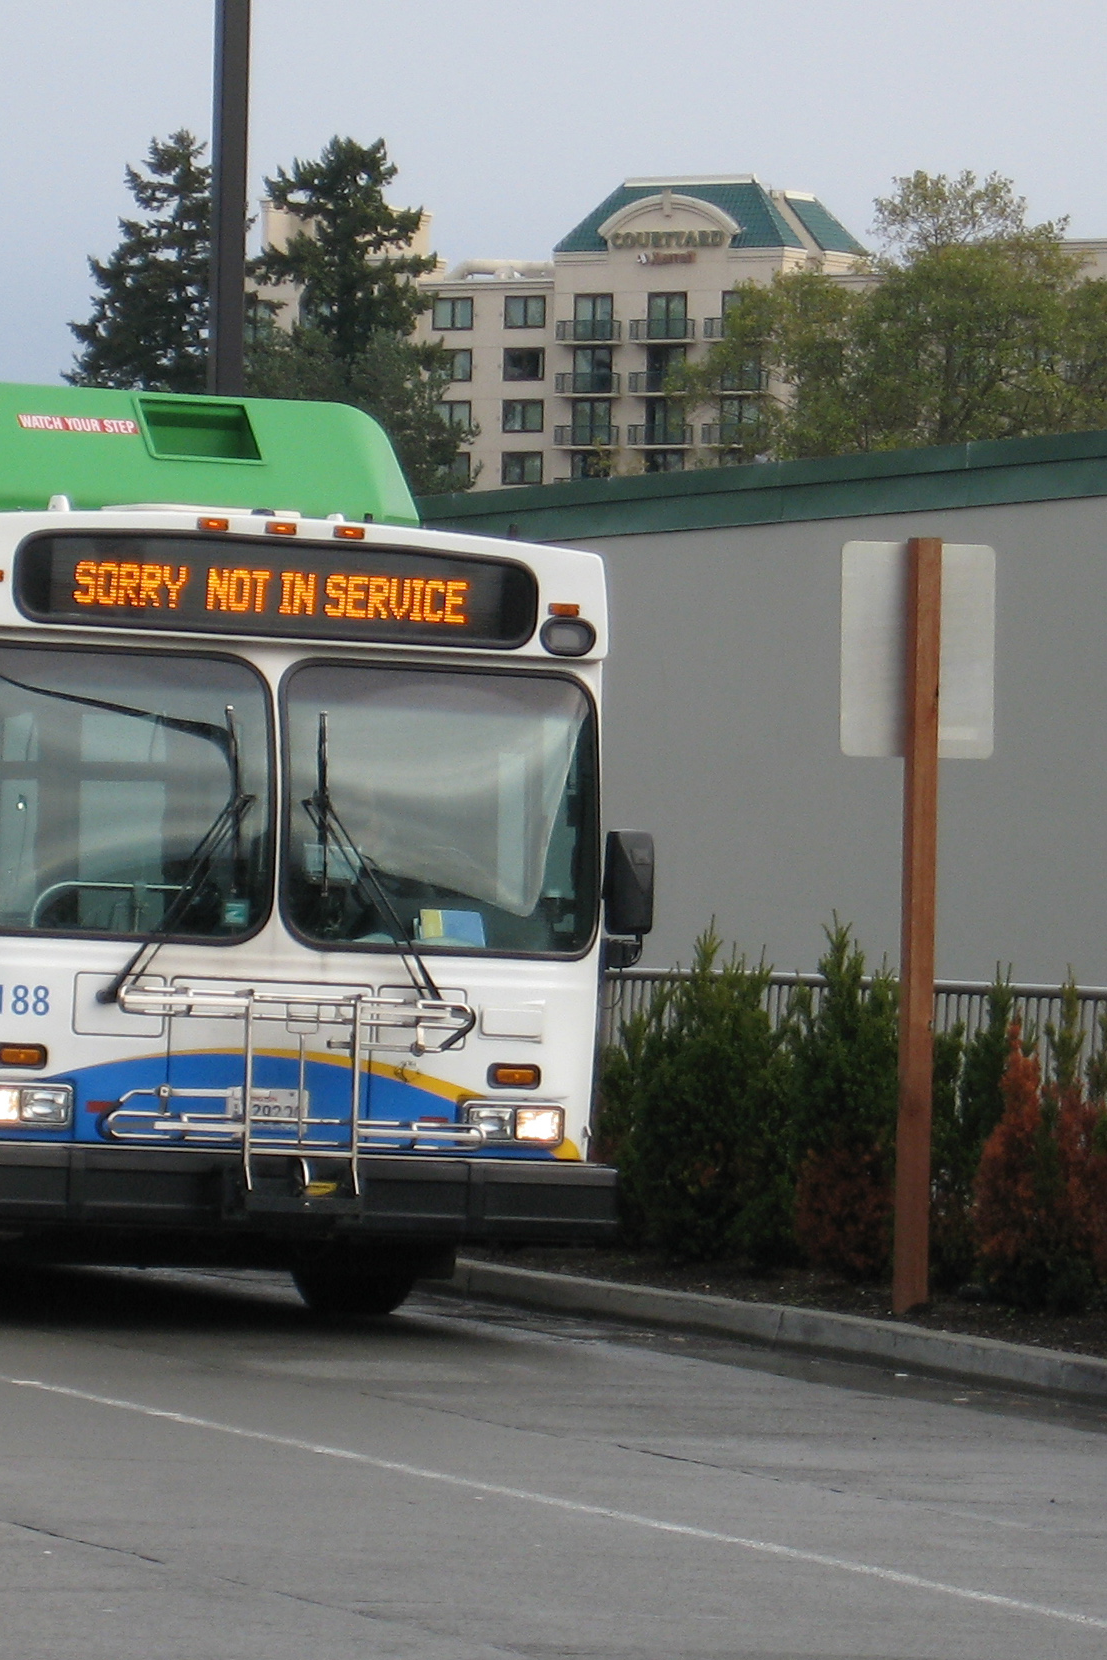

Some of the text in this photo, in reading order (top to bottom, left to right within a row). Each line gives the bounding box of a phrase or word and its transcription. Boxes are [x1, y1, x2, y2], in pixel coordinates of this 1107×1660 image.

[610, 230, 724, 249] COURTYARD
[18, 414, 135, 433] WATCH YOUR STEP
[73, 561, 470, 625] SORRY NOT IN SERVICE
